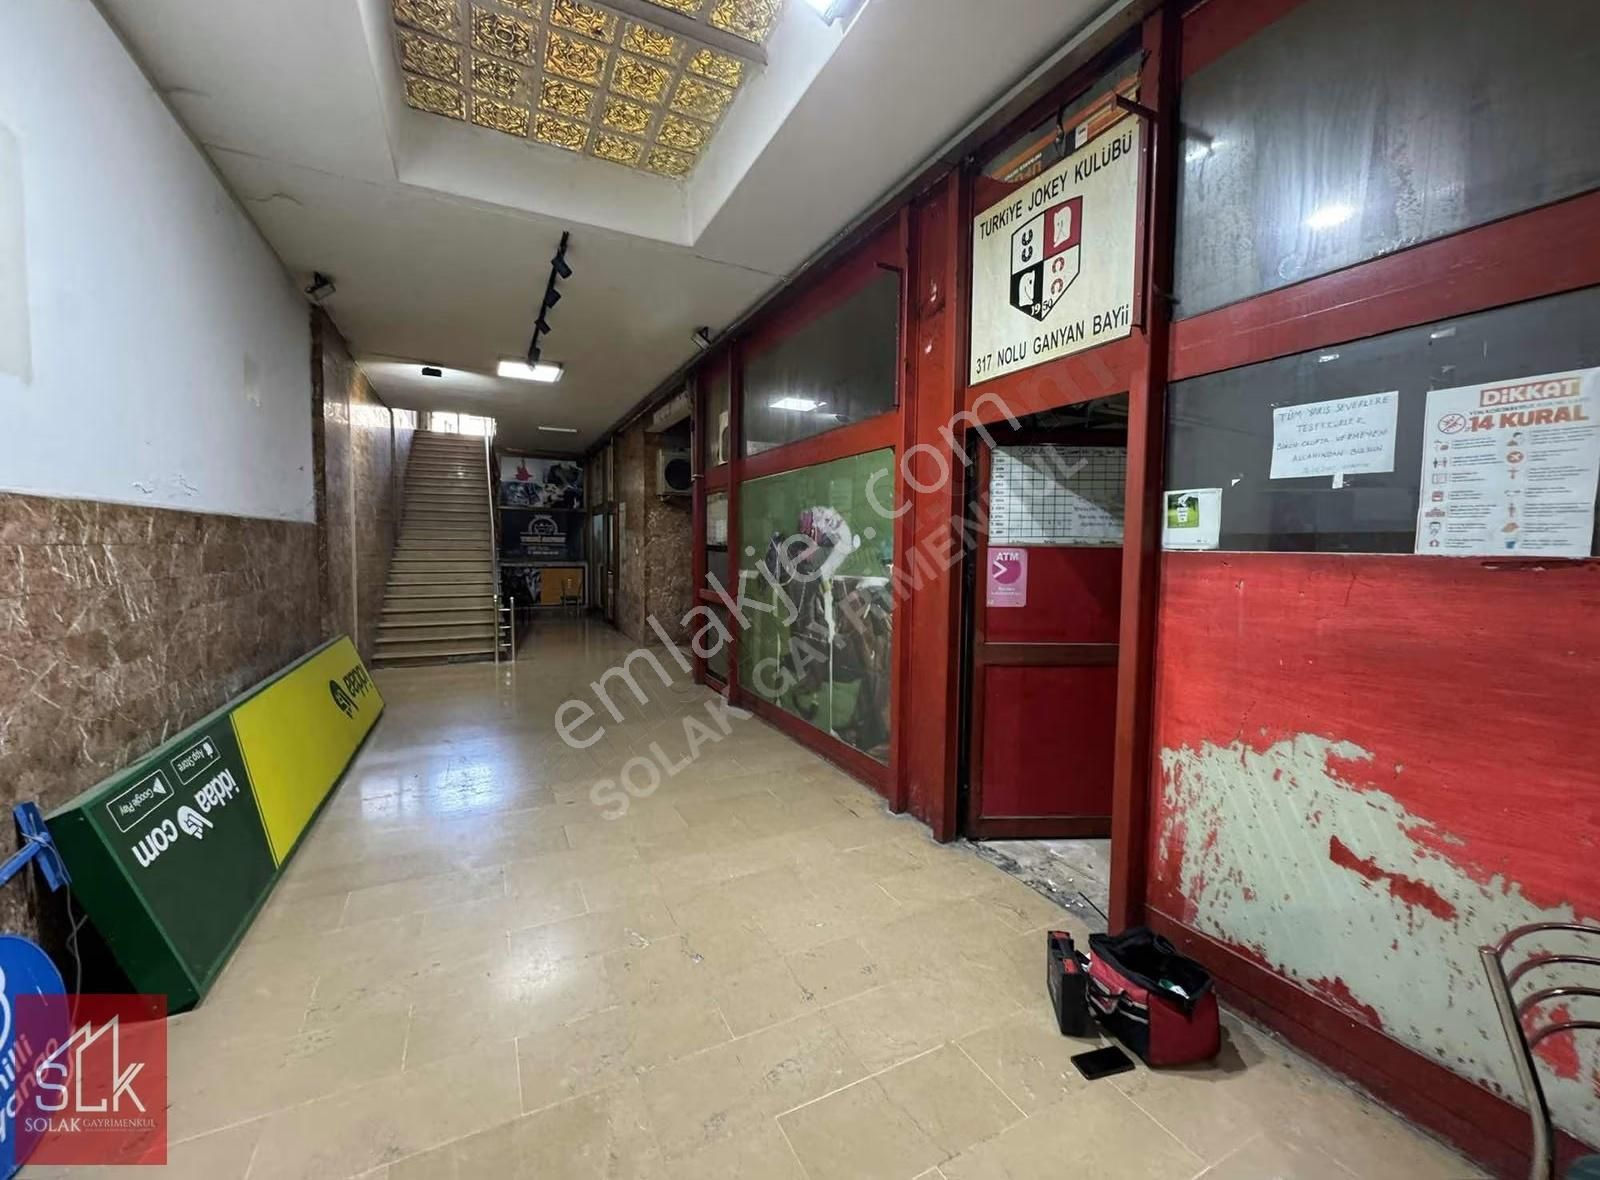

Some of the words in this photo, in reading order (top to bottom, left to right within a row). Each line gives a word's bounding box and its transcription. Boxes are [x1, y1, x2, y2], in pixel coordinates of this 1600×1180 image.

[1028, 171, 1068, 211] JOKEY
[1075, 130, 1132, 184] KULÜBÜ
[976, 354, 992, 374] 317
[998, 341, 1027, 368] NOLU
[1033, 320, 1084, 354] GANYAN
[1469, 415, 1495, 432] 14
[1500, 404, 1589, 428] KURAL
[996, 552, 1020, 561] ATM
[132, 788, 154, 807] Google
[194, 768, 240, 813] iddaa
